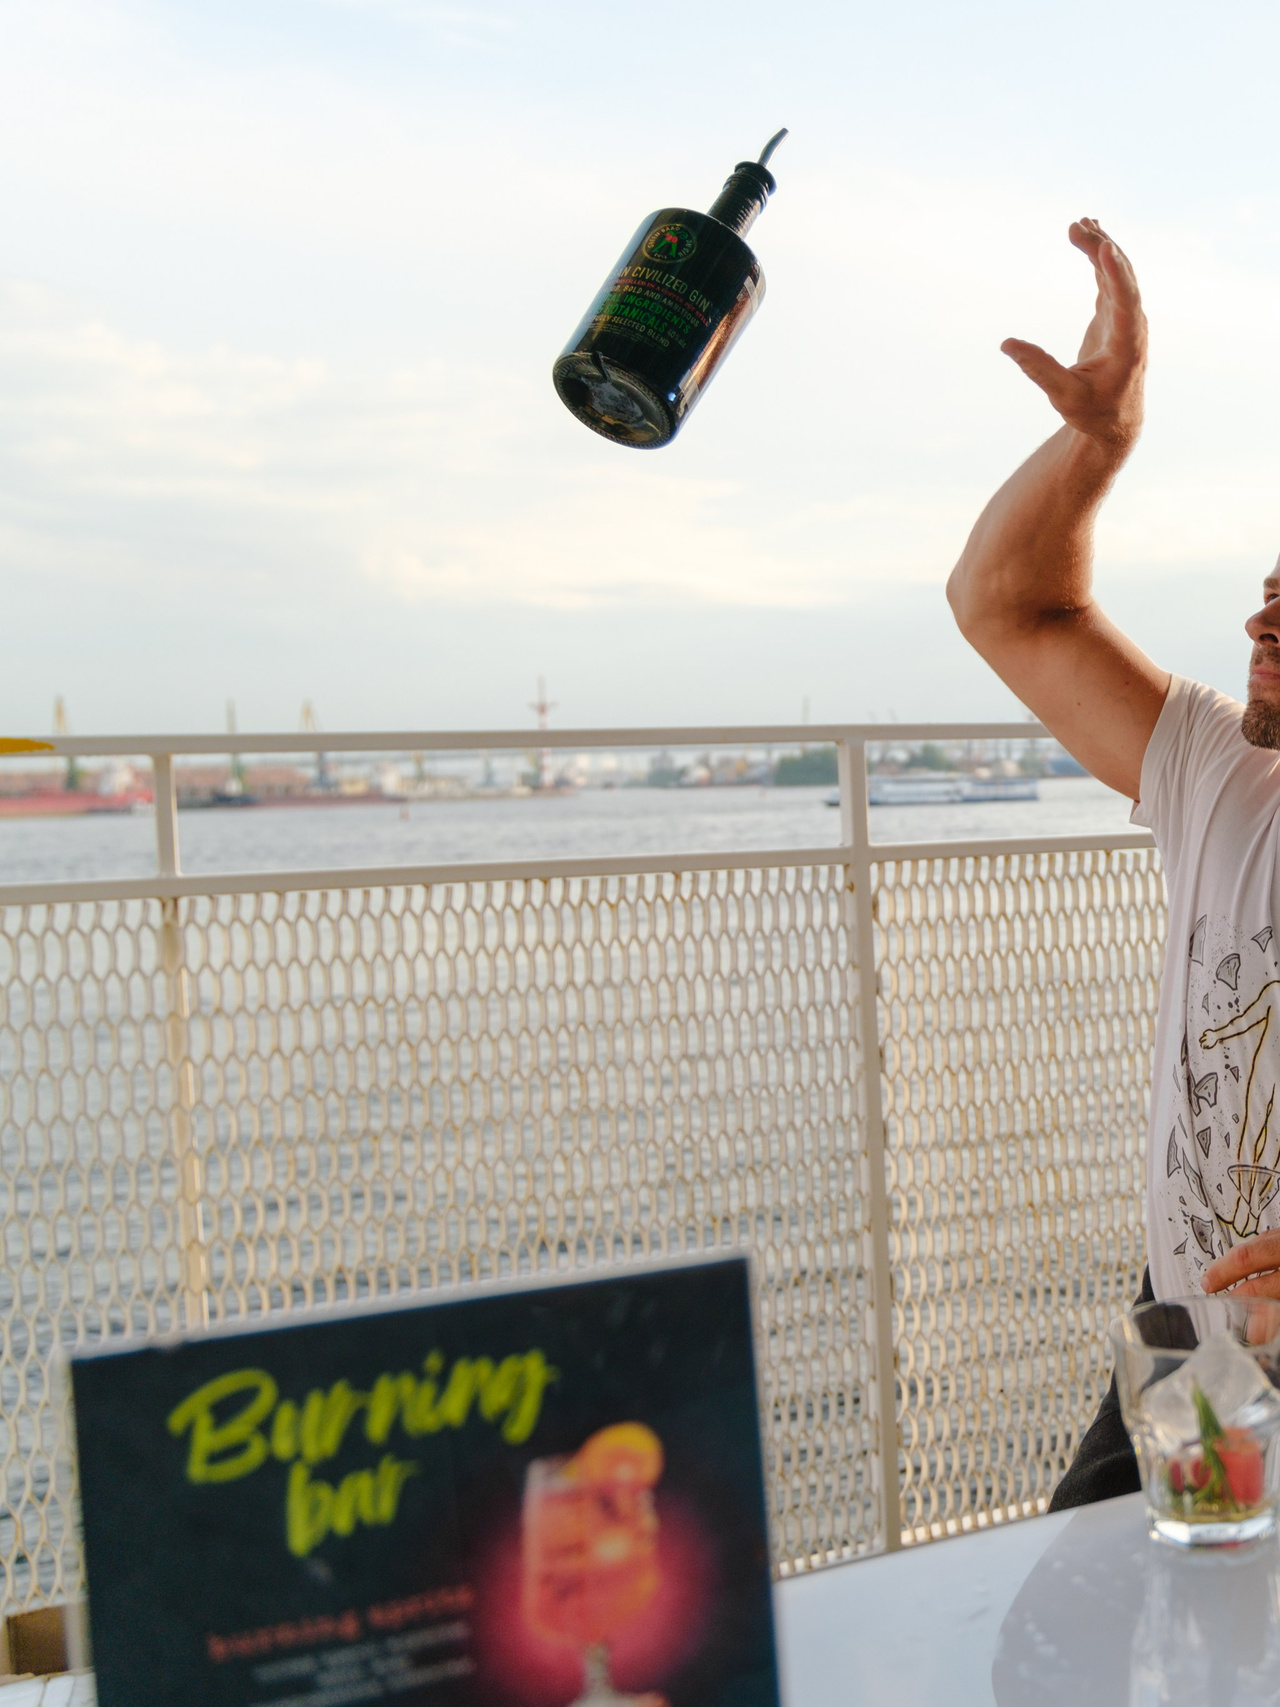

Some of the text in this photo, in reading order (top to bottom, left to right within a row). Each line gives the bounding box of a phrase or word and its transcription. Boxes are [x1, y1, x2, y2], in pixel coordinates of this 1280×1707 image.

[631, 266, 688, 294] CIVILIZED
[603, 303, 668, 334] BOTANICALS
[622, 284, 643, 294] BOLD
[643, 289, 661, 300] AND
[661, 297, 700, 328] AMBITIOUS
[623, 294, 691, 334] INGREDIENTS
[611, 315, 646, 332] SELECTED
[646, 328, 670, 348] BLEND
[166, 1347, 560, 1486] Burning
[285, 1452, 422, 1559] bar
